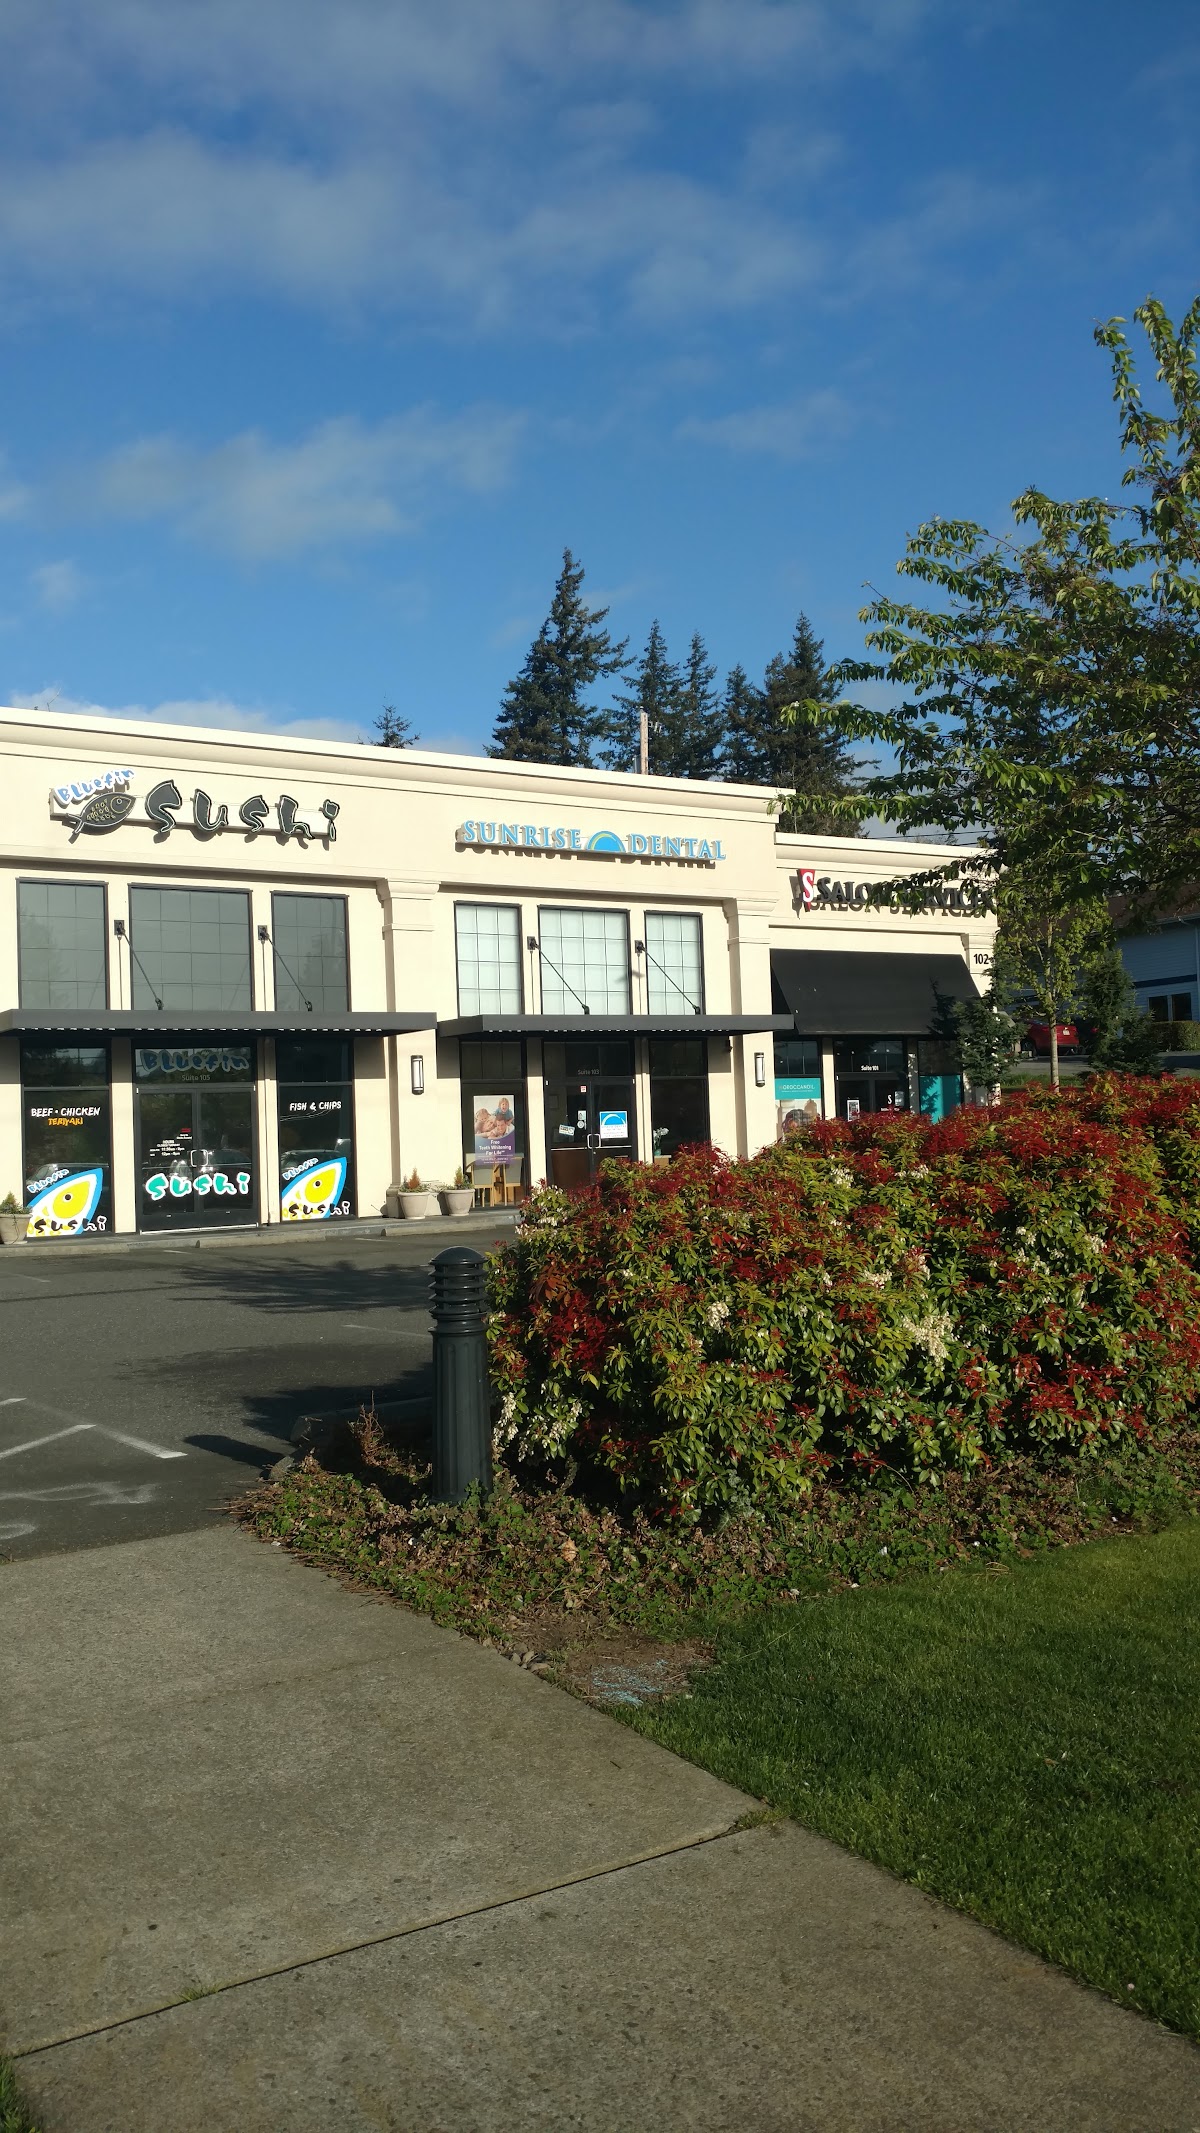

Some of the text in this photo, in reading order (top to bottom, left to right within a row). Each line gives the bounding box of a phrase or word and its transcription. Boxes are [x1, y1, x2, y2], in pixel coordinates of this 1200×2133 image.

[55, 768, 136, 804] Bluefin
[463, 820, 726, 860] SUNRISE DENTAL
[816, 877, 993, 911] SALO RVICE
[31, 1107, 100, 1117] BEEF CHICKEN
[289, 1102, 307, 1111] FISH
[318, 1100, 341, 1110] CHIPS
[48, 1117, 83, 1126] TERIYAKI
